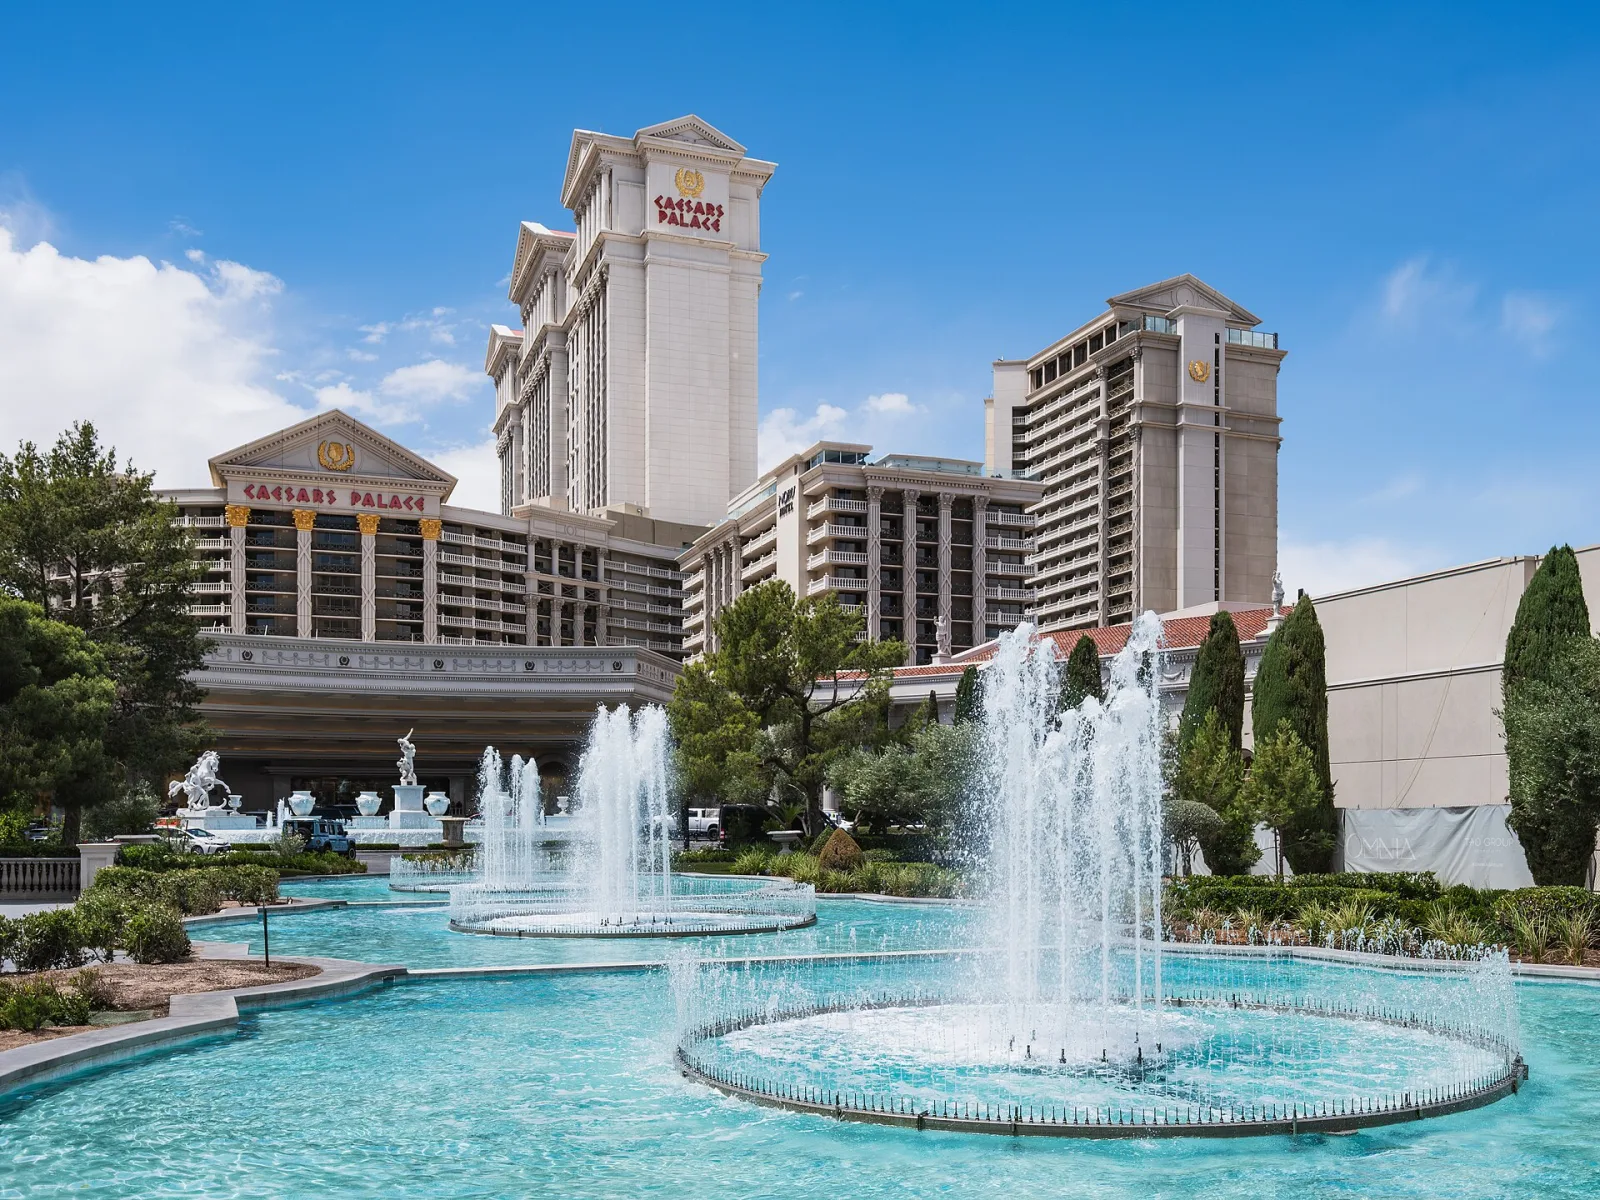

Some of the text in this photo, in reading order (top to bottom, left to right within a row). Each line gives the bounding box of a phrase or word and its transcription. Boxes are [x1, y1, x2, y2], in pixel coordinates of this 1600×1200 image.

[654, 195, 724, 218] CAESARS
[659, 210, 720, 232] PALACE
[243, 484, 425, 512] CAESARS PALACE
[1346, 833, 1416, 860] OMNIA
[1483, 837, 1514, 847] GROUP
